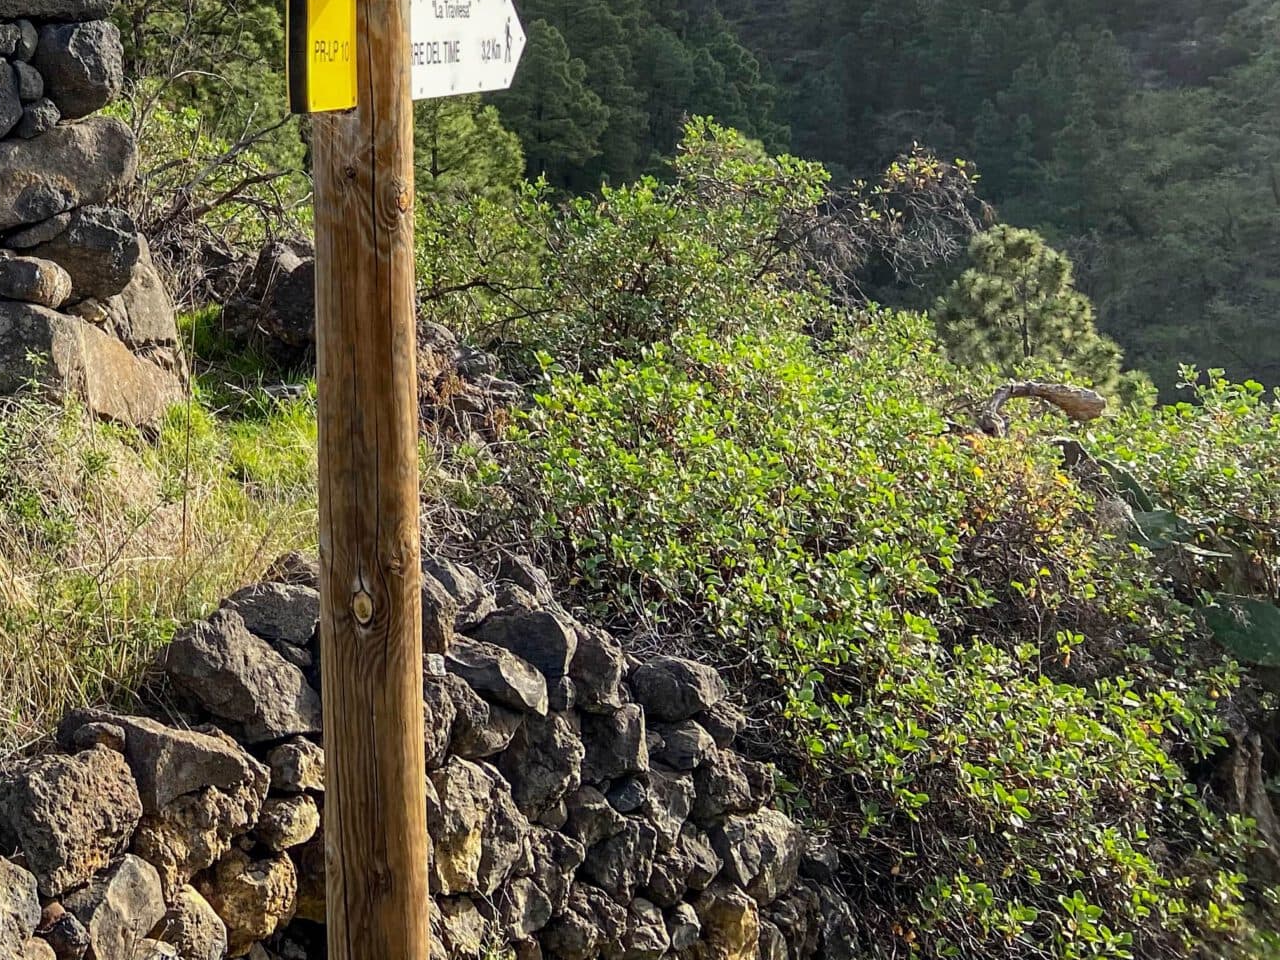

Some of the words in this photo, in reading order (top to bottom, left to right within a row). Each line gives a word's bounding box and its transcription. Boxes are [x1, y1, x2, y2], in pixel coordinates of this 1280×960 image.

[432, 0, 444, 19] "La
[444, 0, 471, 18] Traviesa"
[314, 40, 338, 63] PR-LP
[341, 40, 350, 62] 10
[426, 41, 442, 64] DEL
[443, 40, 460, 63] TIME
[492, 38, 501, 59] Km
